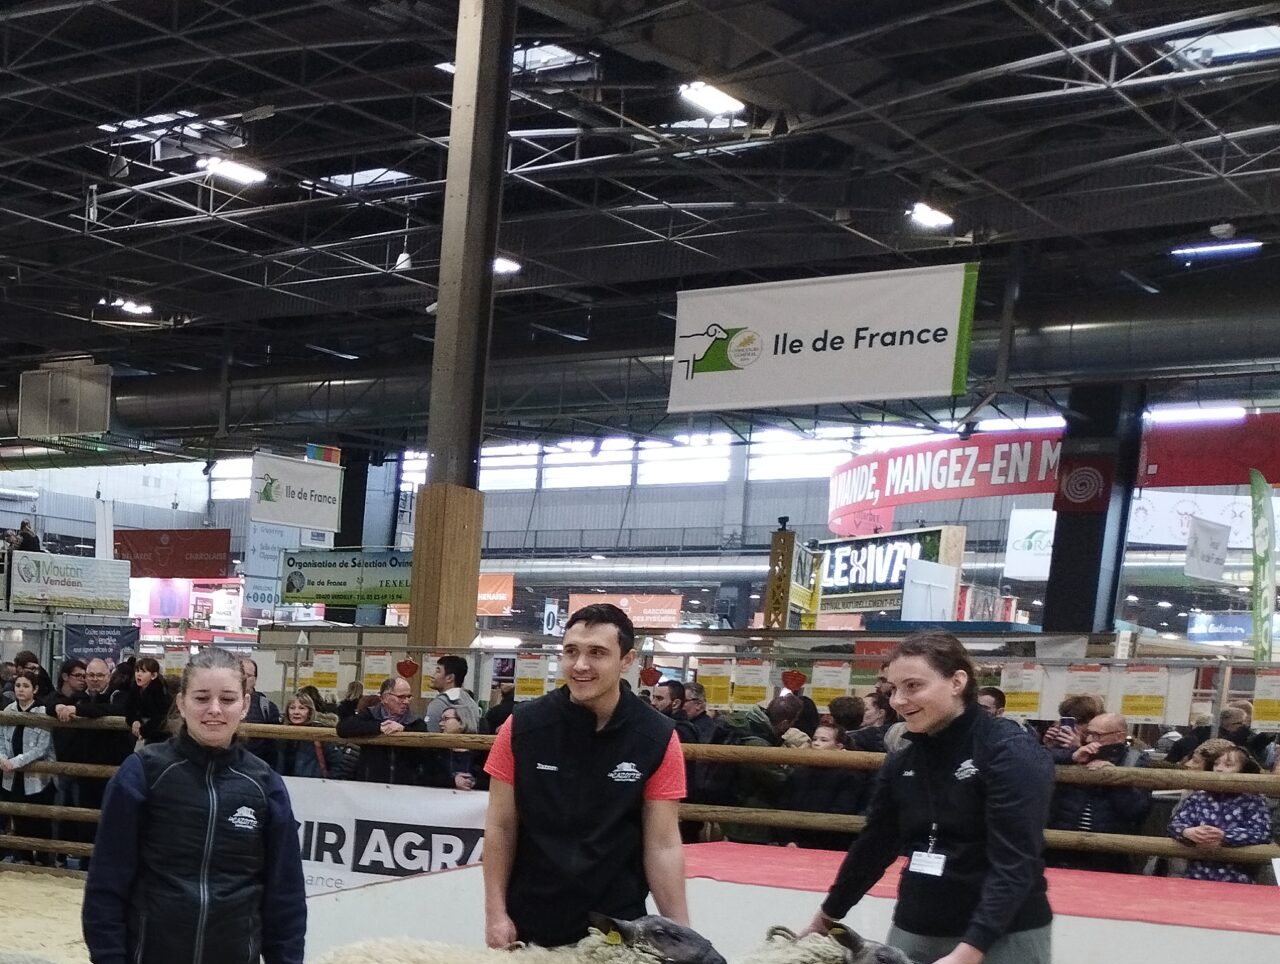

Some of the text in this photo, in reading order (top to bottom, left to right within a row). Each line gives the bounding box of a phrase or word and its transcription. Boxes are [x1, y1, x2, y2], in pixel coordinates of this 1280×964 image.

[773, 326, 948, 355] Ile de France
[885, 441, 1031, 498] MANGEZ-EN
[285, 485, 337, 505] Ile de France
[41, 560, 82, 578] Mouton
[287, 557, 337, 570] Organisation
[339, 559, 349, 568] de
[351, 557, 387, 568] Sélection
[41, 575, 82, 588] Vendéen
[326, 579, 347, 587] France
[379, 579, 410, 588] TEXEL
[305, 874, 343, 889] ance
